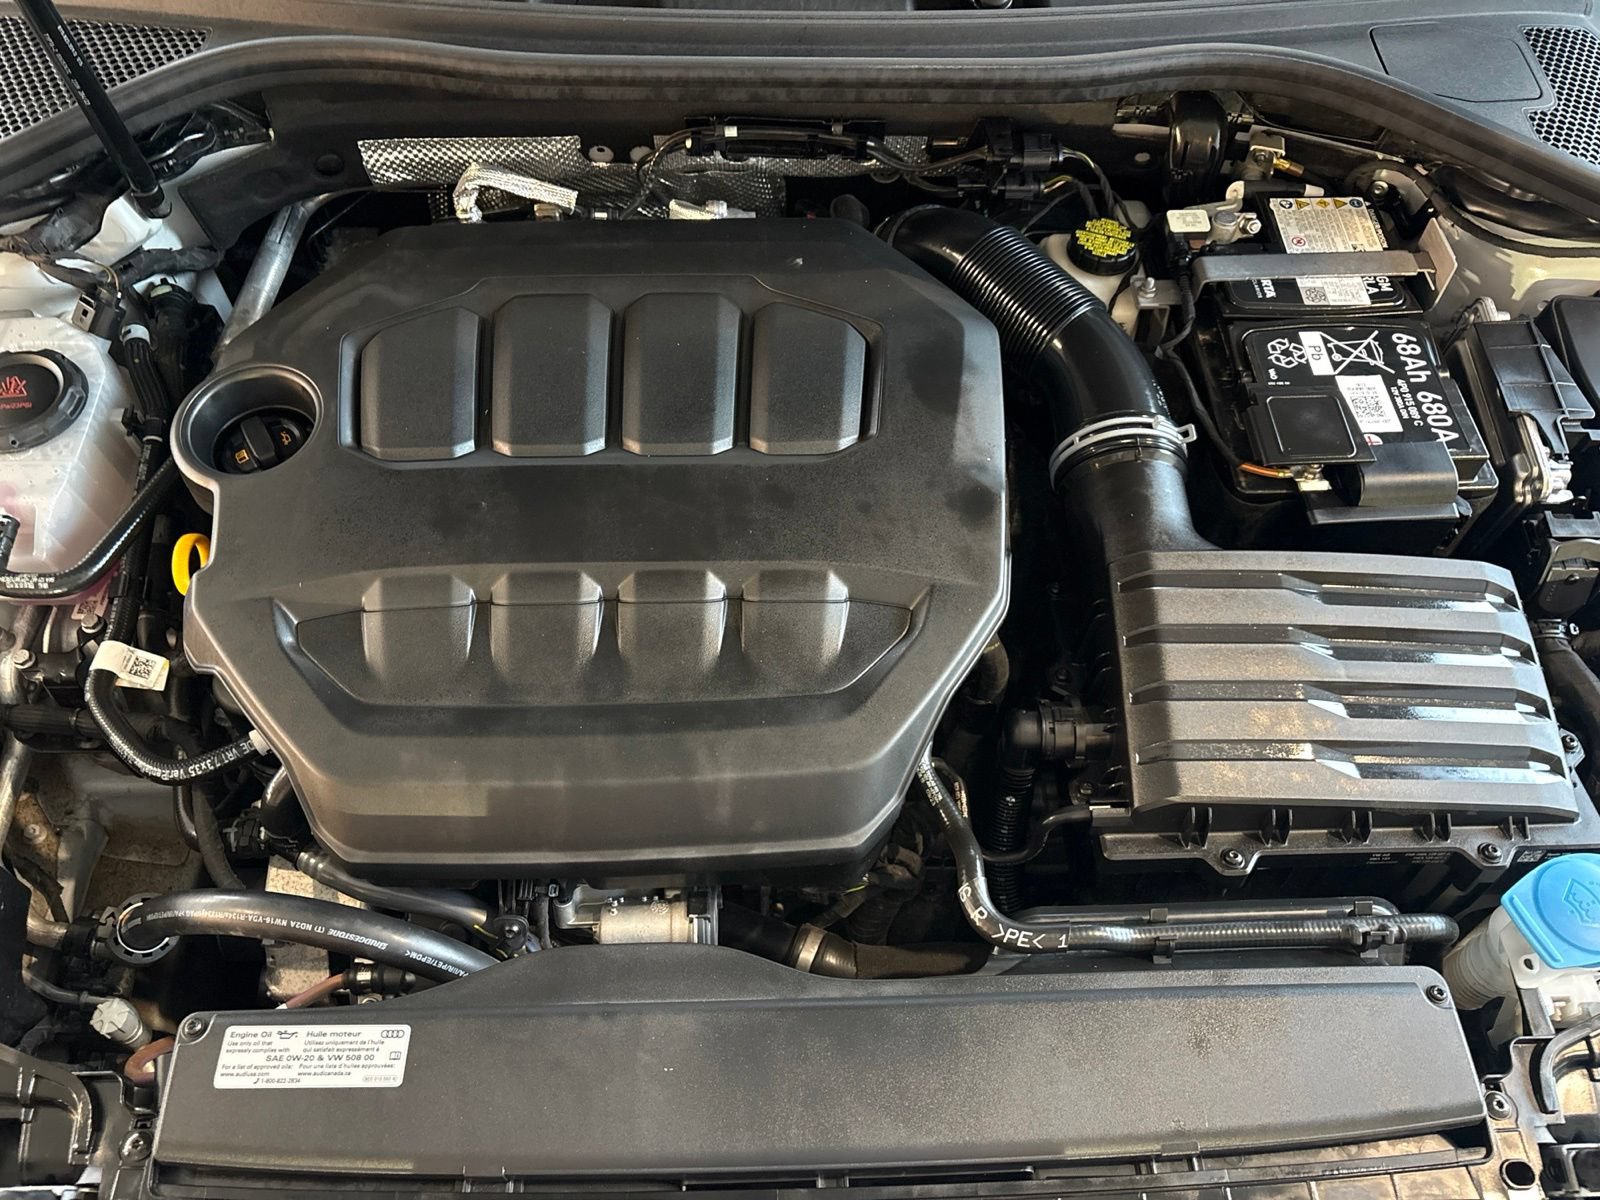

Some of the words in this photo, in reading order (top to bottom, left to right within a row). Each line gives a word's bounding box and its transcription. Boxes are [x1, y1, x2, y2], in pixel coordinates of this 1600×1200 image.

[1260, 279, 1276, 299] RTA
[1362, 276, 1379, 295] RLA
[1376, 276, 1394, 292] GM
[1308, 345, 1323, 360] Pb
[1391, 333, 1432, 382] 68Ah
[1416, 391, 1460, 442] 680A
[1402, 393, 1415, 407] 915
[1057, 934, 1068, 949] 1
[230, 1031, 258, 1039] Engine
[286, 1054, 315, 1062] 0W-20
